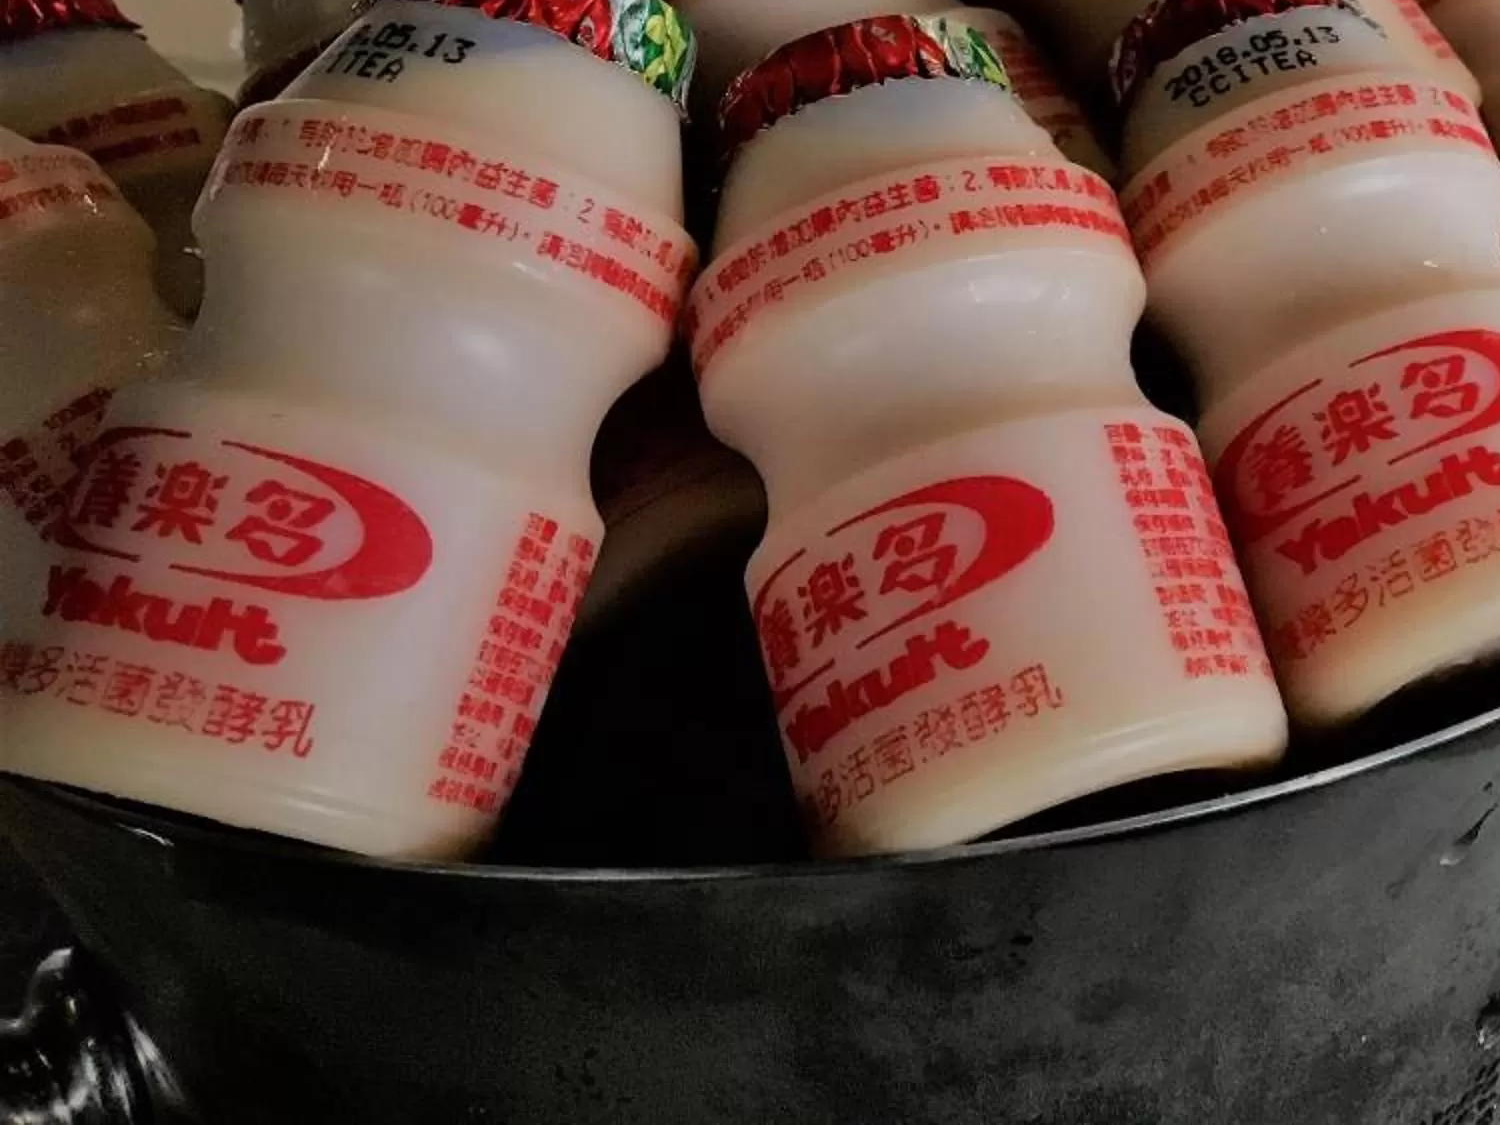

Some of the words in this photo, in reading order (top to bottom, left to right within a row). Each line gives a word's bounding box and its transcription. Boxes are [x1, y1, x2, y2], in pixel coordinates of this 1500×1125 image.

[1164, 26, 1340, 101] 2018.05.13
[42, 565, 287, 665] Yakult
[785, 620, 989, 764] Yakult
